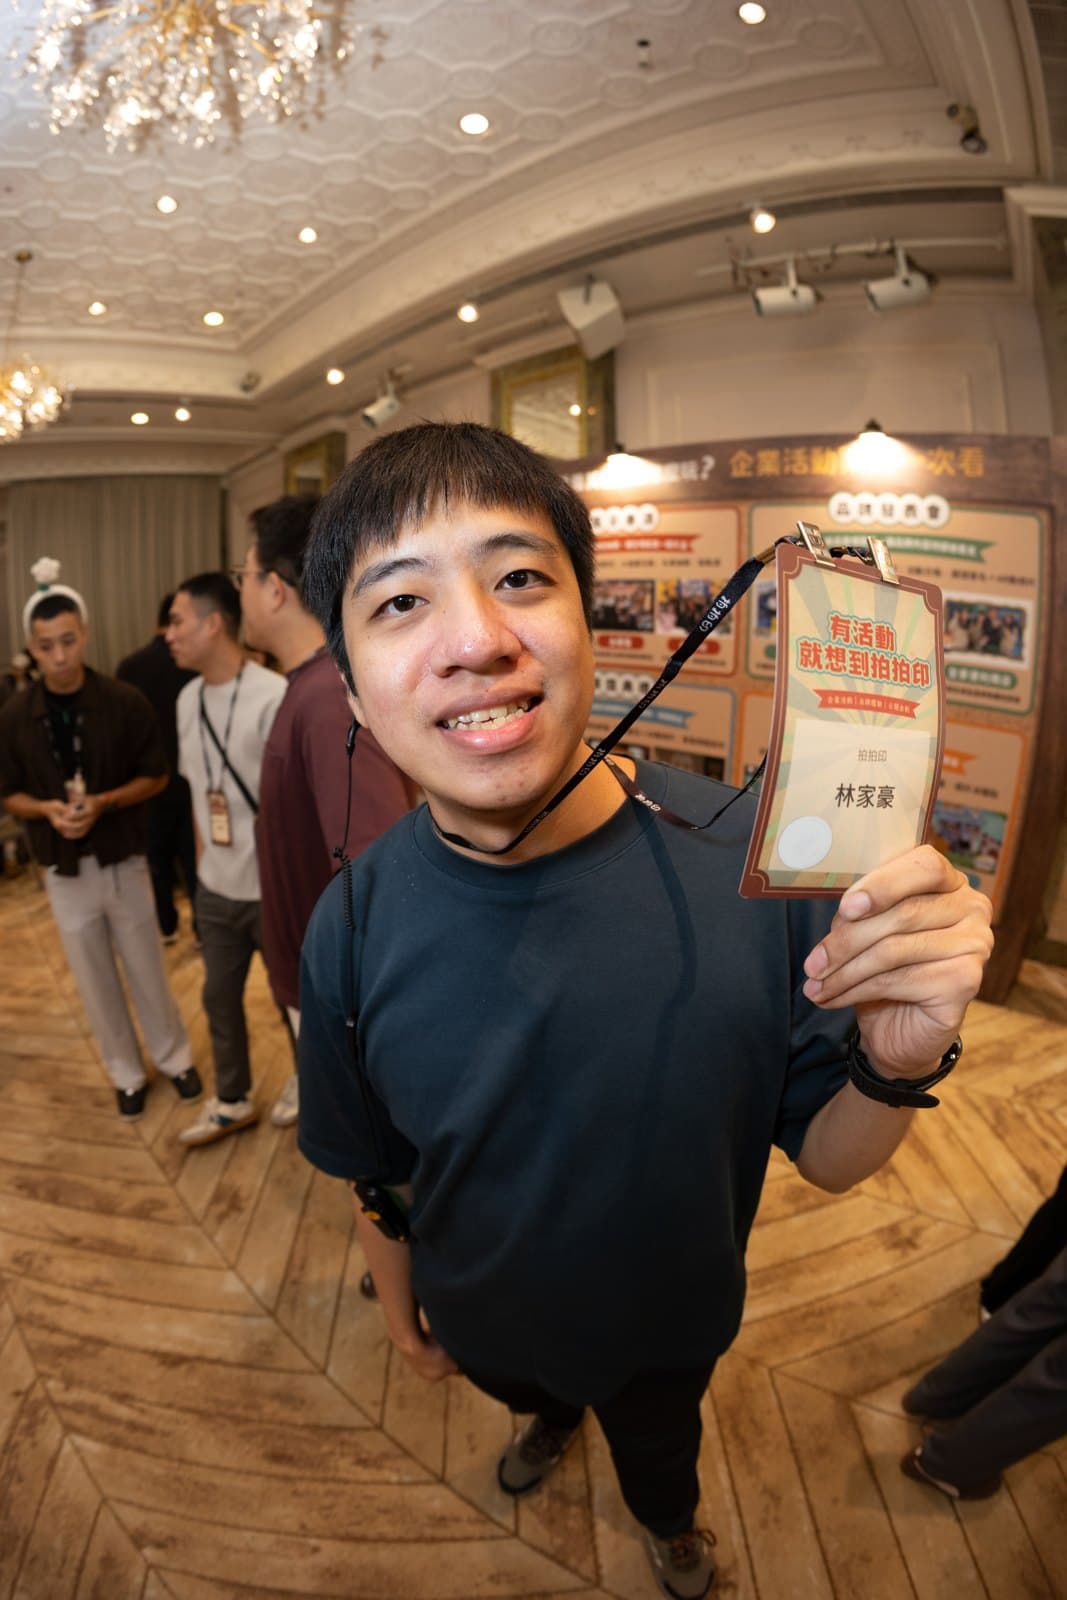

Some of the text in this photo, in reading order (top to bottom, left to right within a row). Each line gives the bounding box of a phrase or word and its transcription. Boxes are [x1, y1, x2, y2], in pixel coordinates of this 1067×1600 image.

[830, 615, 895, 652] 有活動
[800, 640, 930, 687] 就想到拍拍印
[857, 749, 888, 762] 拍拍印
[835, 783, 896, 809] 林家豪
